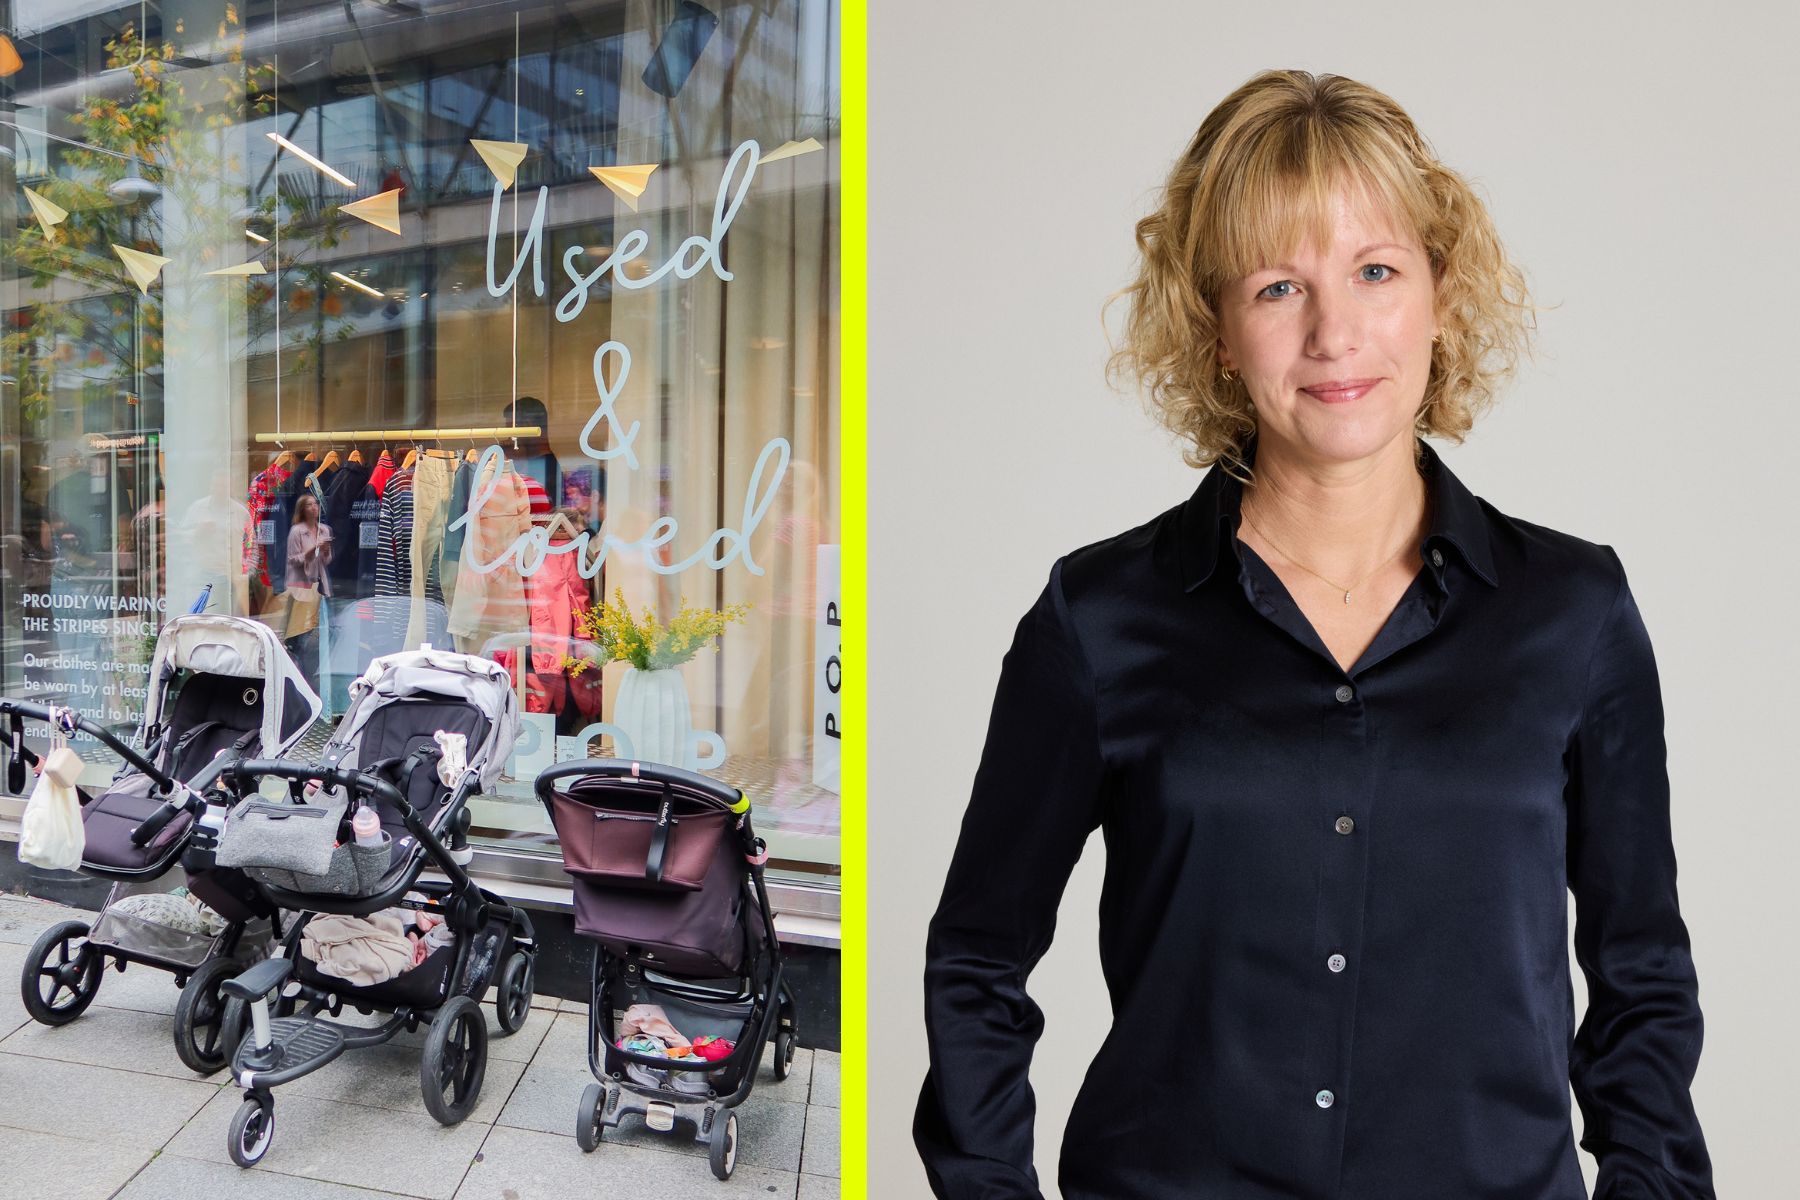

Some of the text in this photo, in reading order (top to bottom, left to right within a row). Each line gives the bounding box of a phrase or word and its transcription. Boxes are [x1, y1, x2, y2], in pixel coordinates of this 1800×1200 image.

[486, 139, 761, 322] Used
[579, 340, 640, 470] &
[22, 593, 168, 612] PROUDLY WEARING
[22, 616, 158, 637] THE STRIPES SINCE
[24, 653, 153, 675] Our clothes are ma
[24, 675, 41, 691] be
[43, 681, 78, 693] worn
[81, 680, 98, 698] by
[102, 683, 116, 696] at
[80, 703, 105, 719] and
[108, 706, 123, 721] to
